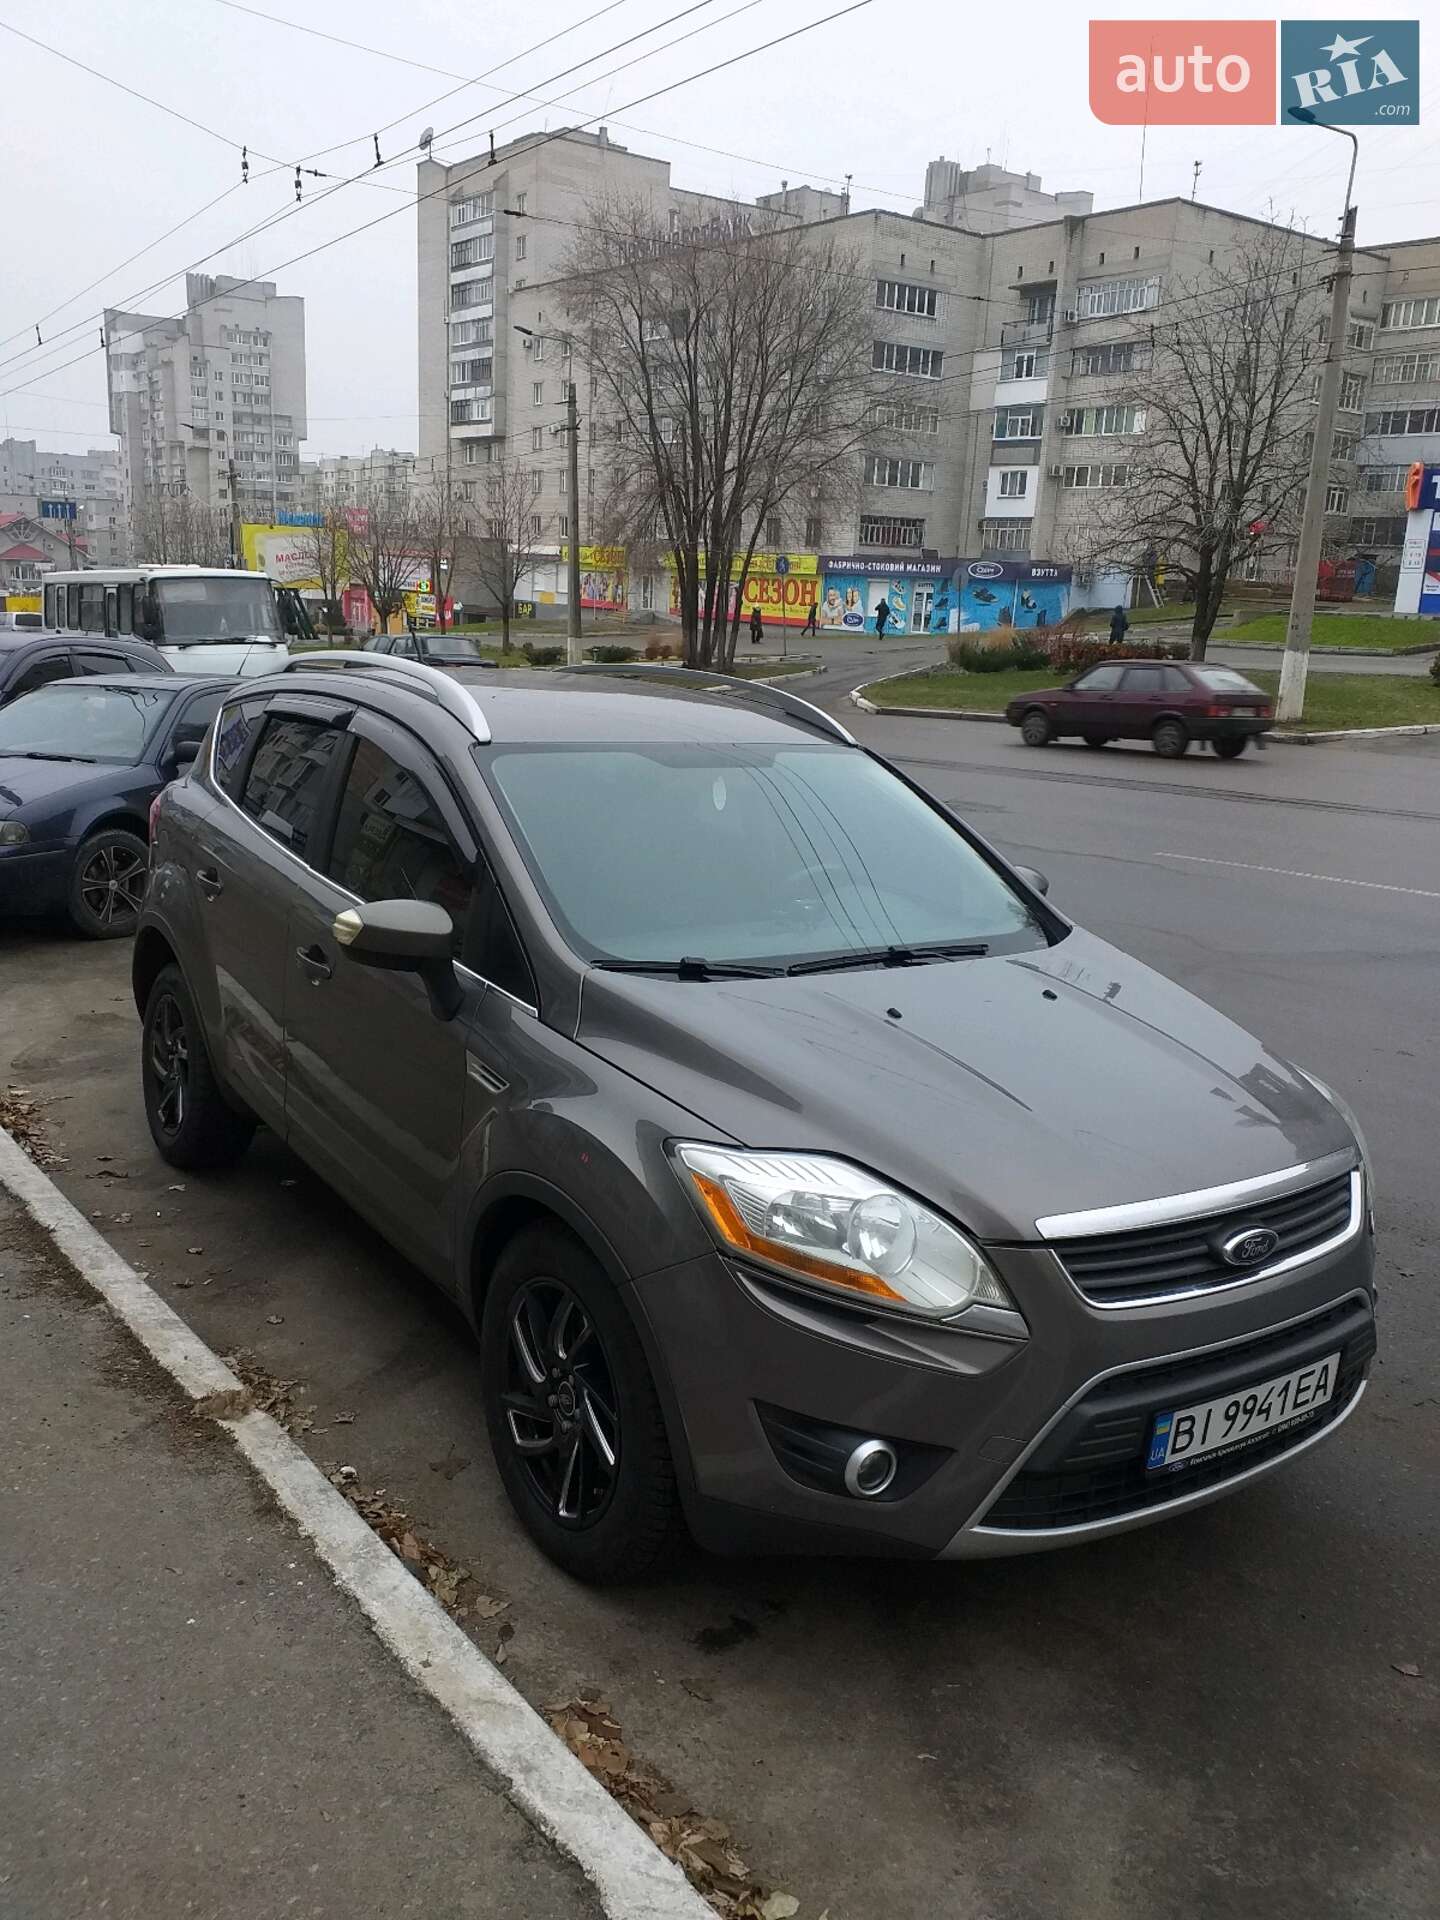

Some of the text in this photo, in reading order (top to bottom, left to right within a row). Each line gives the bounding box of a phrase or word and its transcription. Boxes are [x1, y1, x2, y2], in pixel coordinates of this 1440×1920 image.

[906, 563, 942, 573] МАГАЗИН
[743, 577, 817, 606] СЕЗОН
[517, 603, 533, 615] БАР
[1241, 1236, 1269, 1258] Ford
[1150, 1446, 1165, 1461] UA
